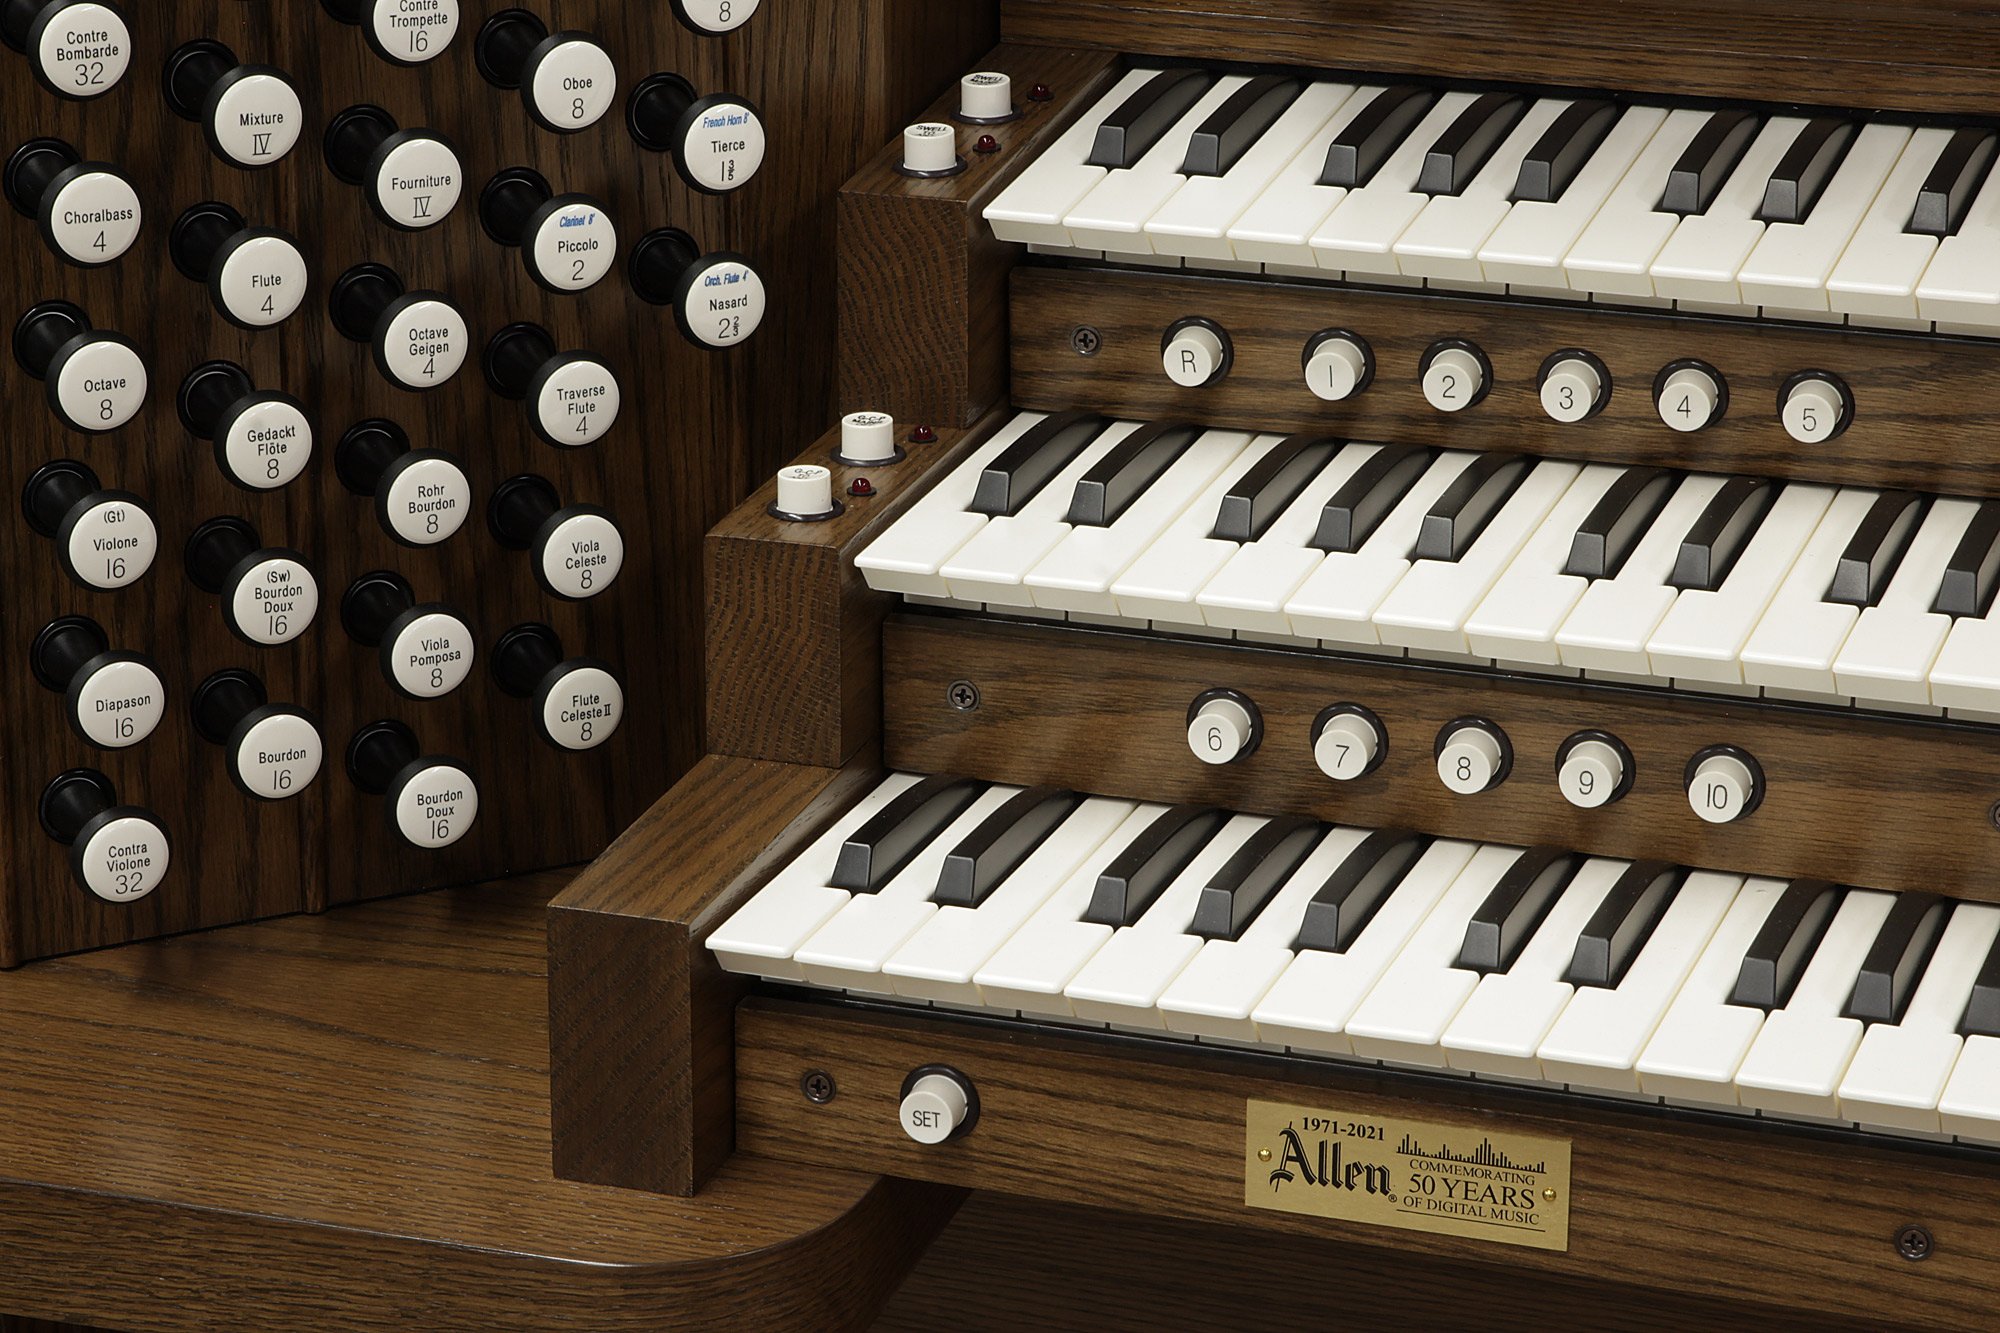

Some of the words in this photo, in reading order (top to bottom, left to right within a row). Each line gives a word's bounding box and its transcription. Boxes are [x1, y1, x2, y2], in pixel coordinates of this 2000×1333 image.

[400, 0, 438, 13] Contre
[719, 1, 731, 22] 8
[389, 12, 448, 29] Trompette
[67, 30, 108, 45] Contre
[410, 30, 428, 52] 16
[57, 43, 118, 61] Bombarde
[75, 62, 104, 86] 32
[563, 77, 592, 90] Oboe
[572, 98, 584, 119] 8
[240, 113, 283, 126] Mixture
[703, 117, 726, 128] French
[726, 115, 743, 126] Horn
[252, 133, 272, 156] IV
[711, 140, 745, 153] Tierce
[392, 175, 451, 190] Fourniture
[413, 195, 432, 218] IV
[64, 209, 132, 224] Choralbass
[559, 215, 586, 228] Clarinet
[93, 230, 106, 252] 4
[558, 238, 598, 253] Piccolo
[572, 260, 584, 281] 2
[723, 273, 740, 285] Flute
[252, 274, 281, 288] Flute
[261, 294, 274, 315] 4
[710, 294, 747, 311] Nasard
[409, 328, 448, 341] Octave
[409, 342, 449, 357] Geigen
[423, 358, 435, 378] 4
[1181, 350, 1196, 373] R
[84, 379, 126, 392] Octave
[557, 386, 605, 401] Traverse
[1442, 375, 1456, 398] 2
[1559, 386, 1573, 410] 3
[100, 399, 113, 420] 8
[568, 401, 595, 415] Flute
[1677, 395, 1691, 419] 4
[576, 416, 588, 435] 4
[1802, 407, 1816, 432] 5
[247, 425, 295, 442] Gedackt
[267, 458, 279, 479] 8
[418, 484, 445, 498] Rohr
[409, 498, 455, 514] Bourdon
[104, 509, 125, 523] (Gt)
[427, 514, 438, 534] 8
[93, 537, 138, 551] Violone
[572, 540, 599, 554] Viola
[107, 558, 125, 579] 16
[566, 554, 606, 569] Celeste
[267, 569, 290, 583] (Sw)
[581, 569, 592, 589] 8
[255, 584, 302, 599] Bourdon
[264, 601, 293, 613] Doux
[270, 615, 287, 636] 16
[421, 637, 449, 652] Viola
[410, 651, 461, 667] Pomposa
[431, 668, 442, 688] 8
[96, 696, 150, 712] Diapason
[572, 694, 600, 707] Flute
[561, 706, 602, 723] Celeste
[116, 717, 133, 739] 16
[581, 722, 592, 739] 8
[1208, 727, 1222, 751] 6
[259, 748, 306, 764] Bourdon
[1336, 744, 1350, 768] 7
[1456, 756, 1471, 781] 8
[274, 769, 291, 790] 16
[1579, 770, 1594, 795] 9
[417, 790, 462, 806] Bourdon
[1707, 783, 1728, 810] 10
[427, 806, 454, 819] Doux
[432, 819, 449, 839] 16
[108, 844, 147, 858] Contra
[107, 857, 150, 872] Violone
[116, 872, 143, 894] 32
[912, 1110, 941, 1128] SET
[1303, 1117, 1384, 1141] 1971-2021
[1409, 1159, 1535, 1186] COMMEMORATING
[1409, 1173, 1436, 1196] 50
[1441, 1177, 1535, 1210] YEARS
[1403, 1196, 1422, 1208] OF
[1427, 1199, 1487, 1218] DIGITAL
[1491, 1208, 1540, 1225] MUSIC
